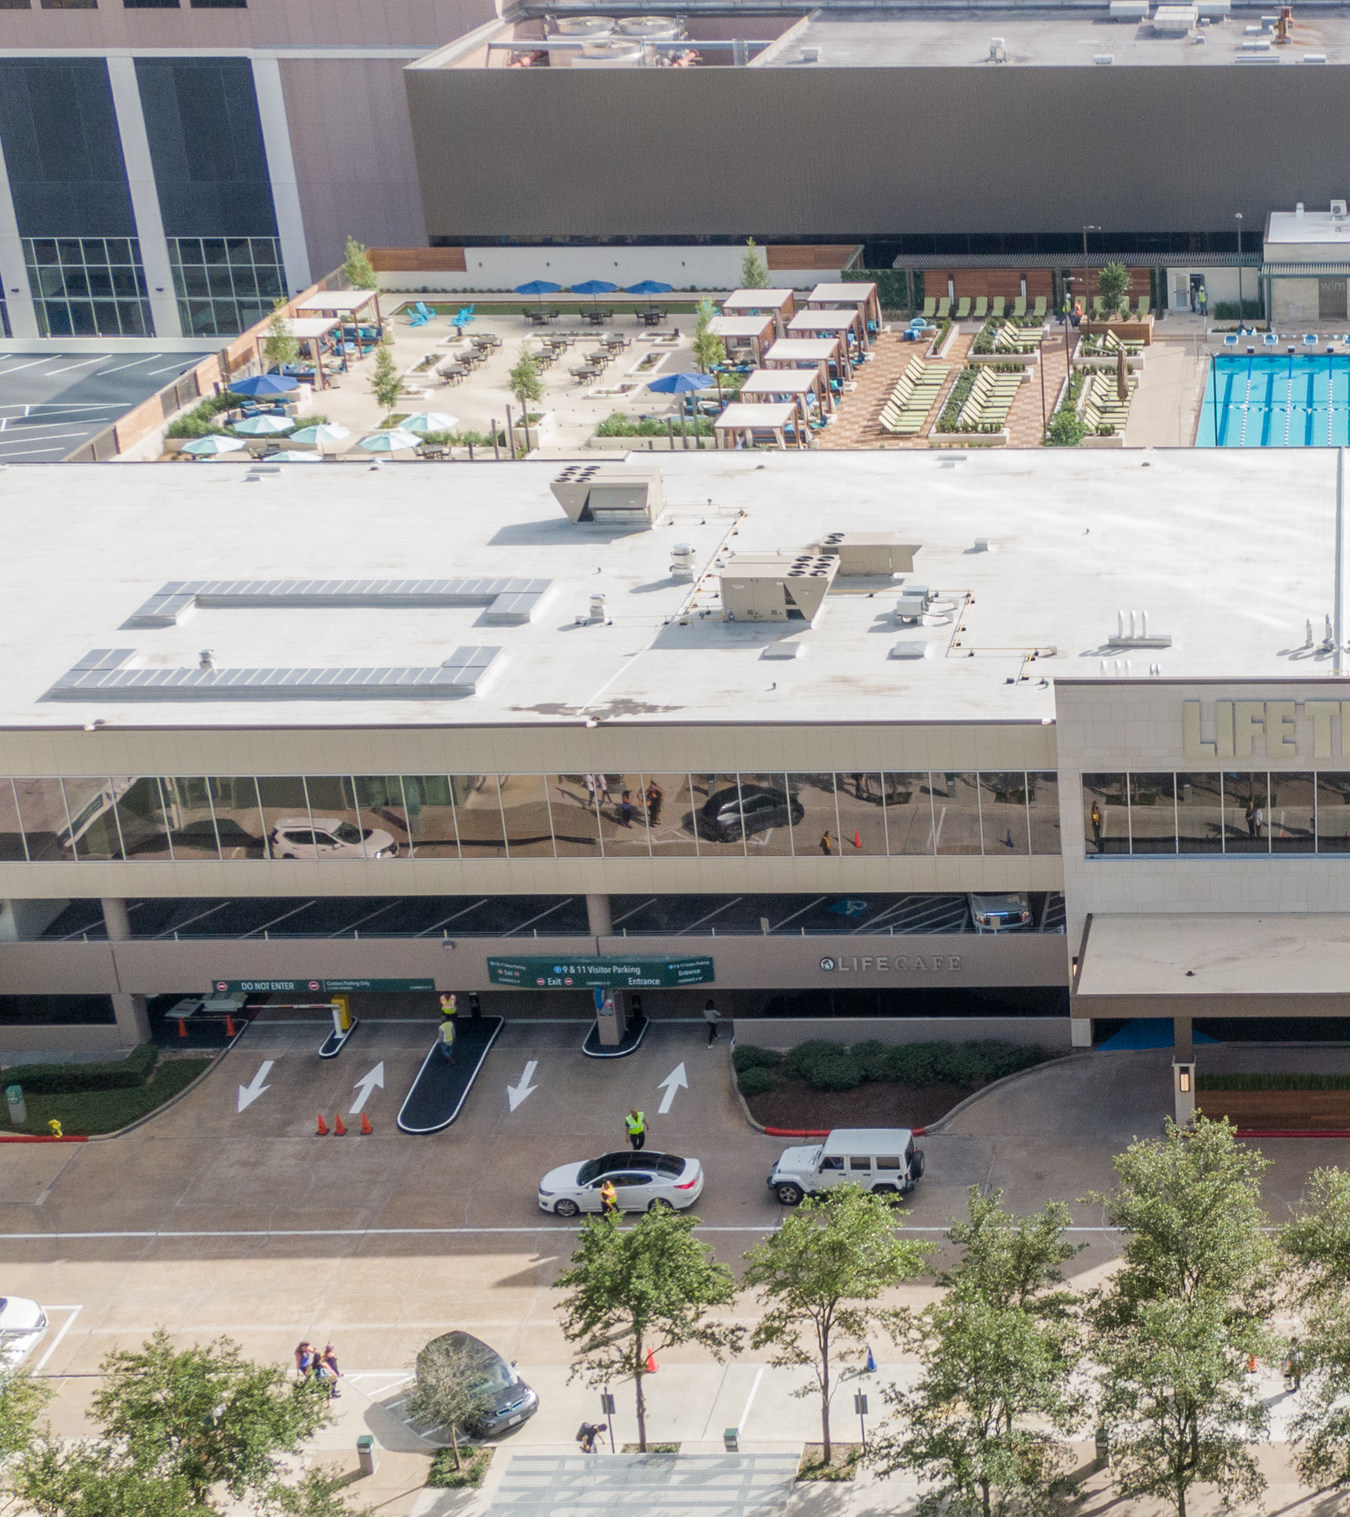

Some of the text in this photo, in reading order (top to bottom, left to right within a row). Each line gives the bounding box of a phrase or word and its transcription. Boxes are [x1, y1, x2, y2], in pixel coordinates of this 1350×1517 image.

[1183, 699, 1296, 757] LIFE
[837, 956, 961, 971] LIFE CAFE
[562, 965, 641, 975] 9 & 11 Visitor Parking
[241, 982, 295, 990] DO NOT ENTER
[547, 977, 660, 986] Exit Entrance
